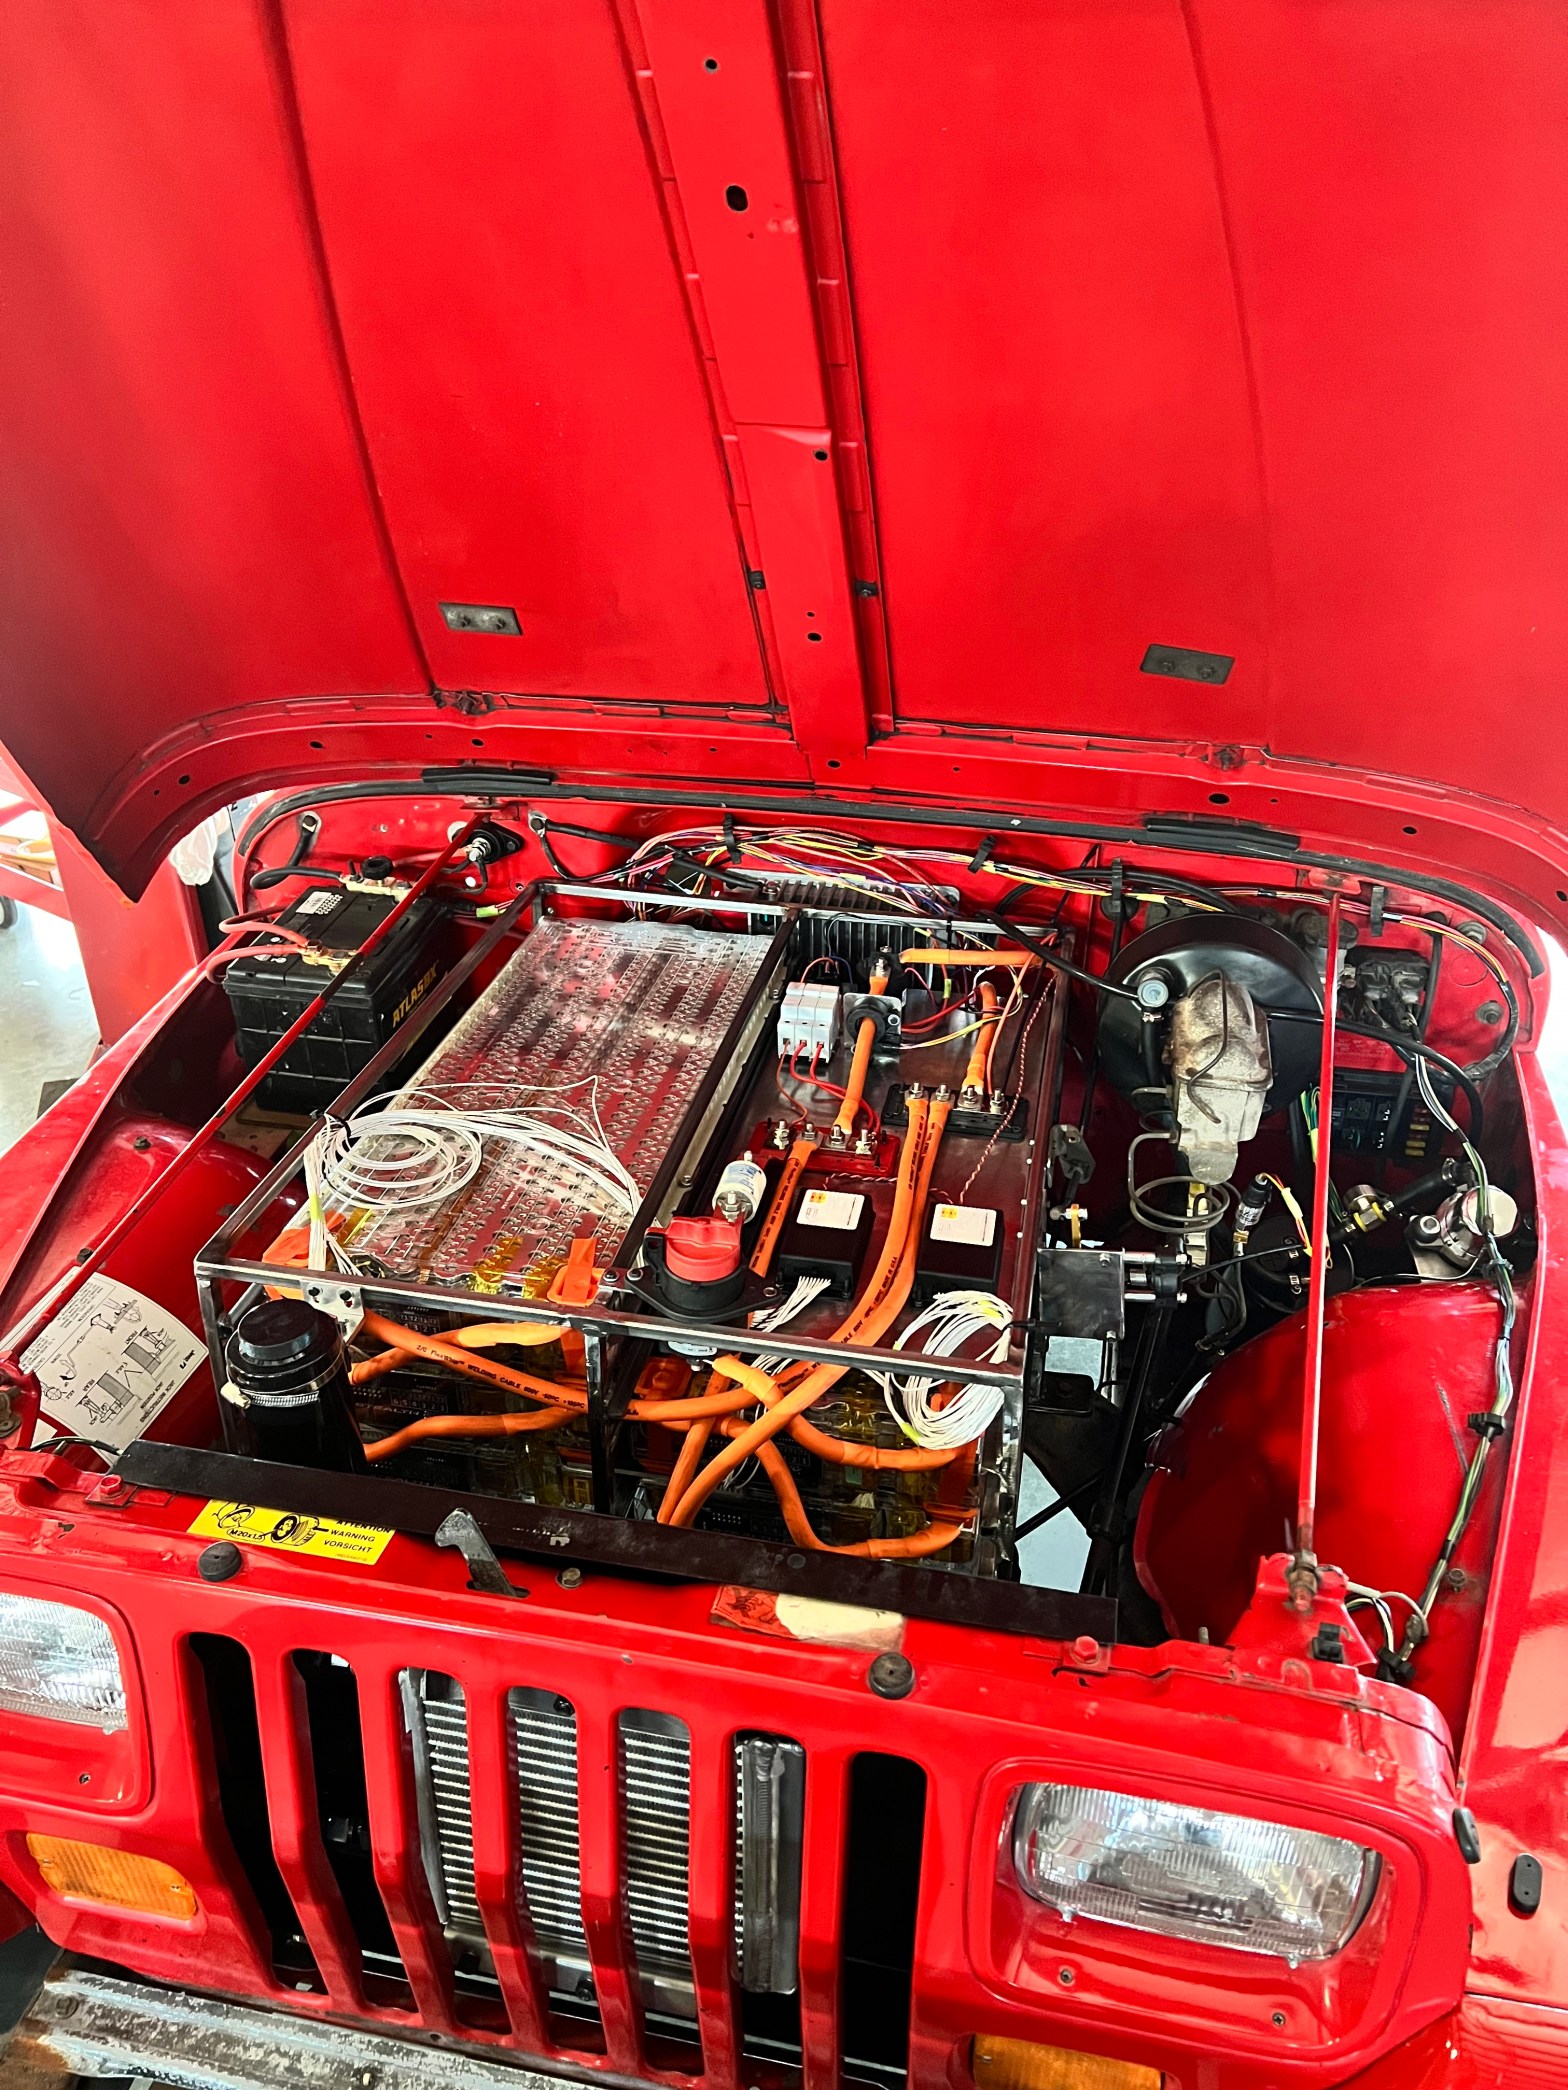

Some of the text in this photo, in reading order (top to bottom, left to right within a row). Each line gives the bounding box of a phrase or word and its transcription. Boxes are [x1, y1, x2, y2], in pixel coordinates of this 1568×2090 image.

[392, 960, 439, 1028] ATLASBX
[125, 1330, 138, 1345] FRONT
[468, 1364, 497, 1379] WELDING
[500, 1377, 521, 1389] CABLE
[82, 1379, 95, 1392] REAR
[331, 1529, 375, 1542] WARNING
[324, 1540, 372, 1553] VORSICHT
